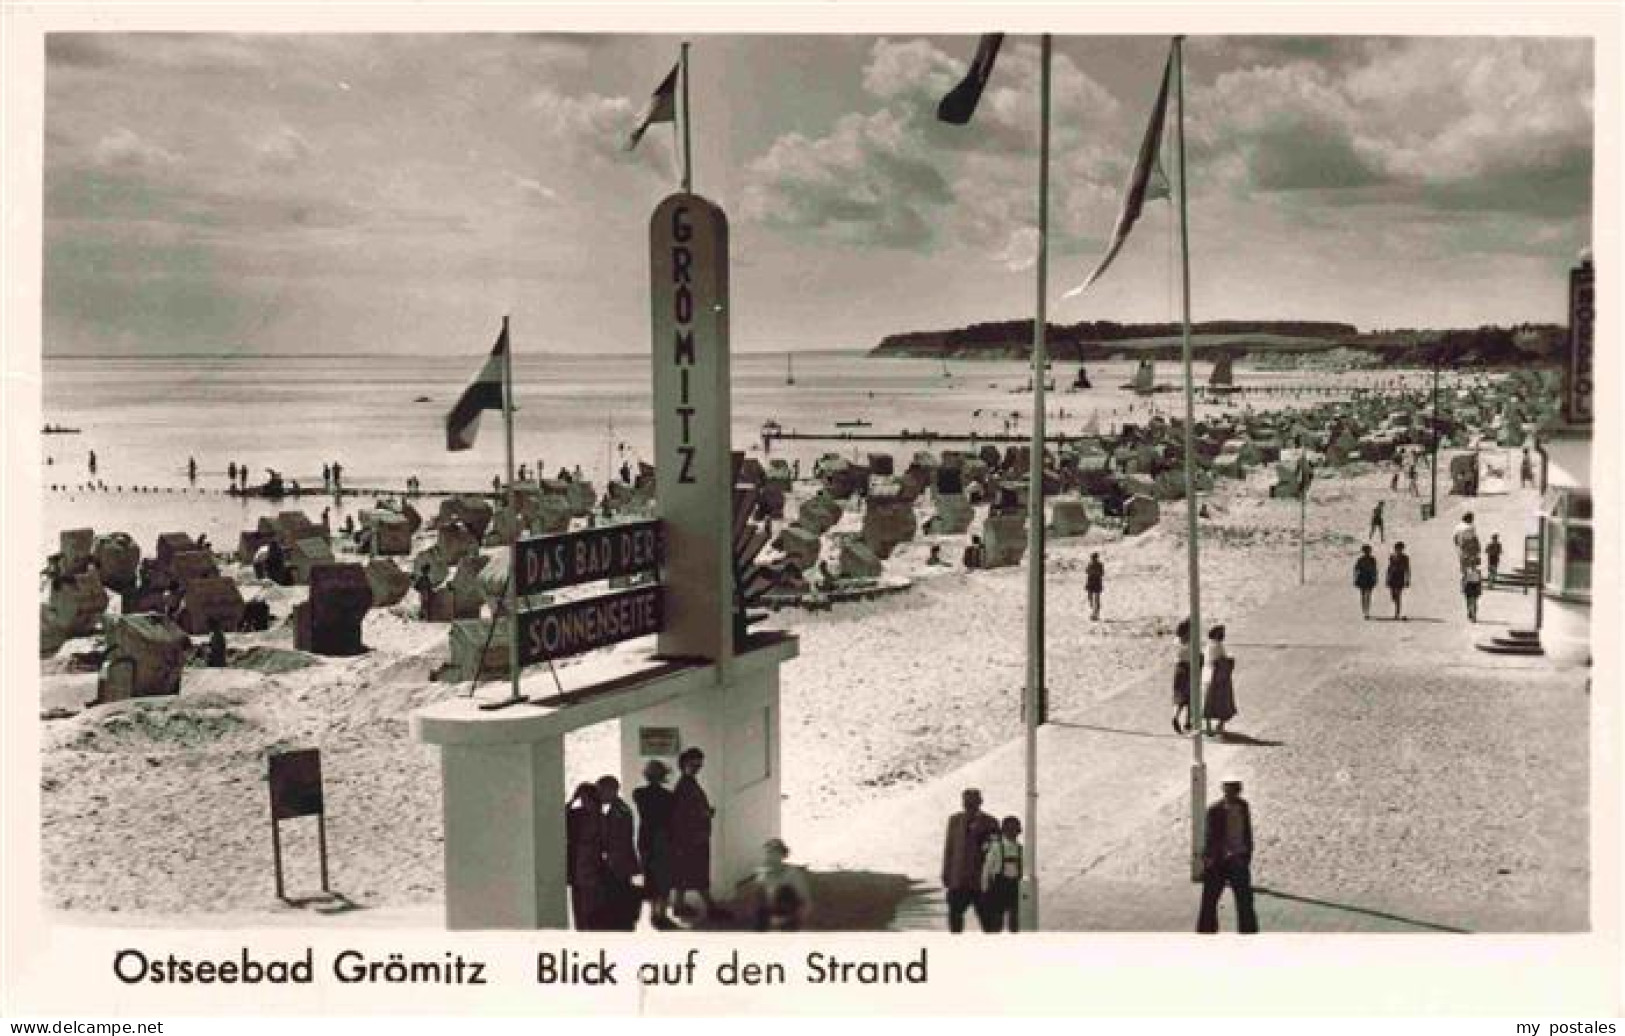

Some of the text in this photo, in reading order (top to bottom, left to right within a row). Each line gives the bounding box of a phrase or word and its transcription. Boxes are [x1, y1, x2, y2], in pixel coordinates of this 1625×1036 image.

[671, 206, 696, 484] GRÖMITZ
[526, 529, 655, 584] DAS BAD DER
[528, 593, 657, 656] SONNENSEITE
